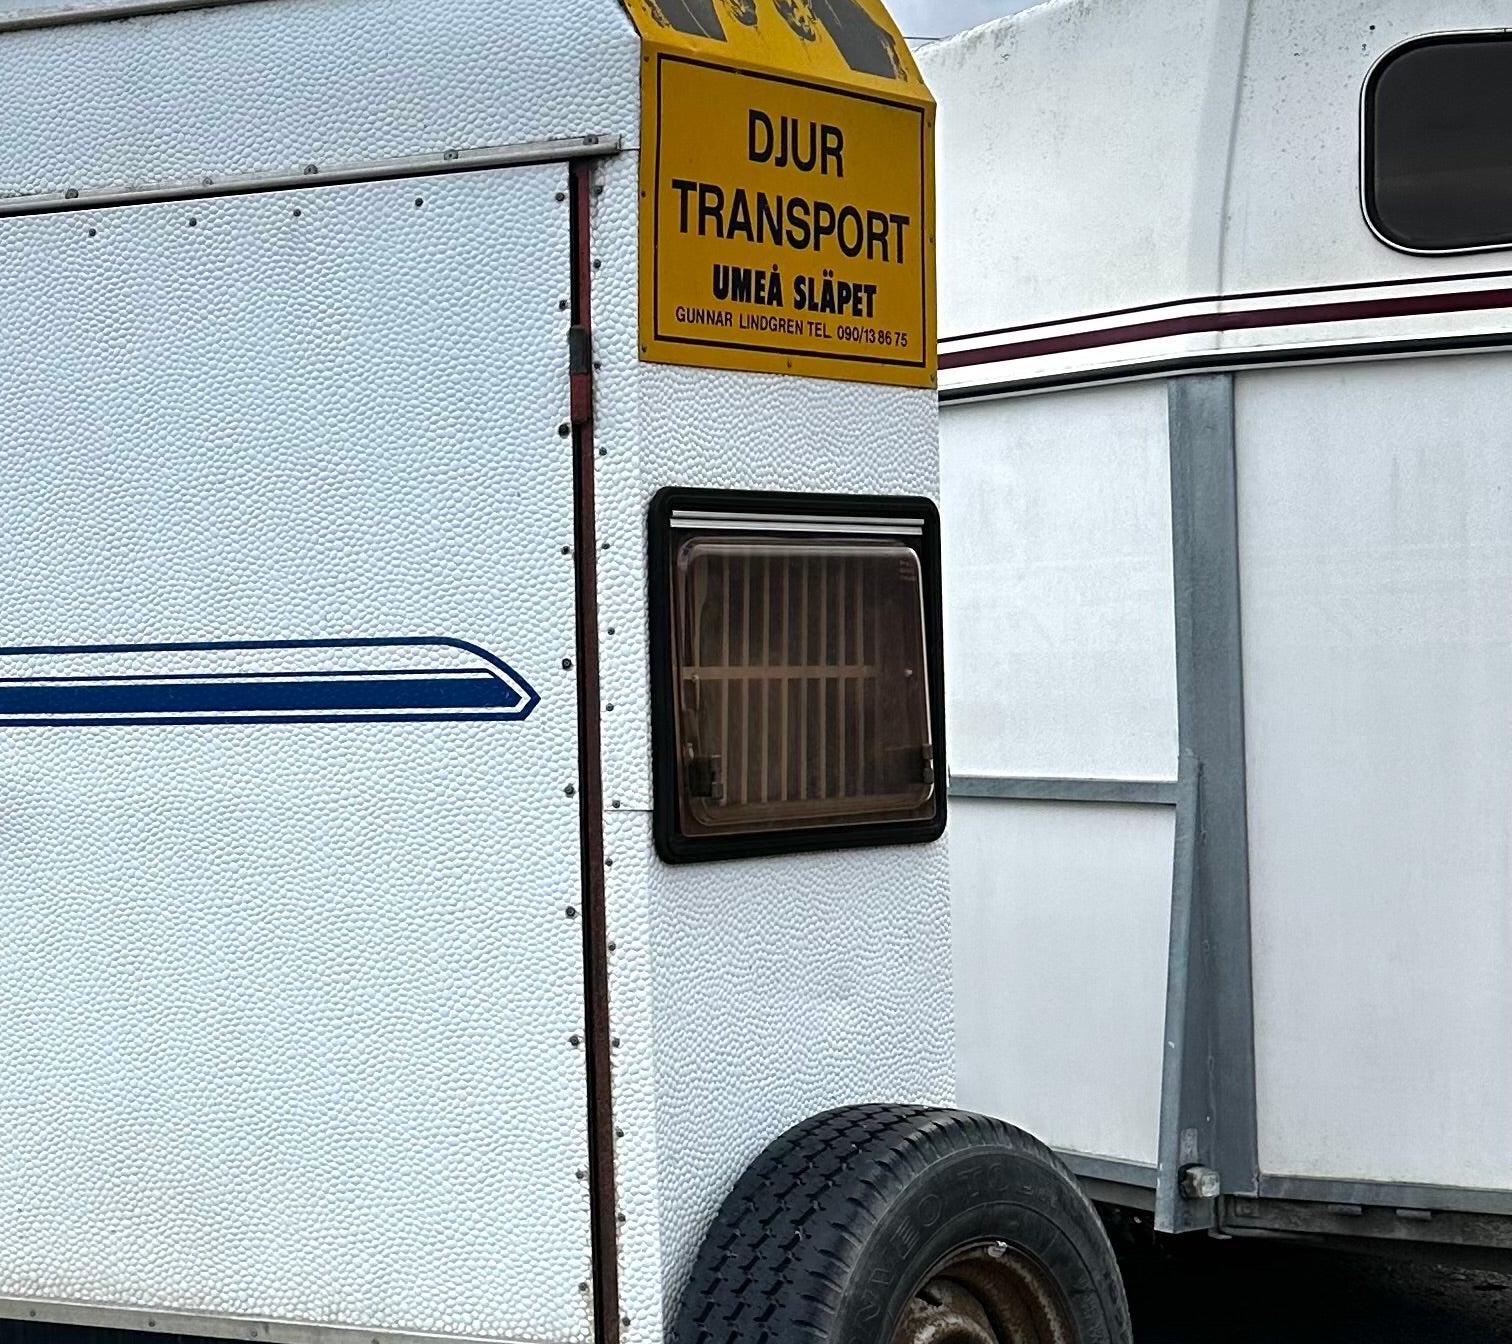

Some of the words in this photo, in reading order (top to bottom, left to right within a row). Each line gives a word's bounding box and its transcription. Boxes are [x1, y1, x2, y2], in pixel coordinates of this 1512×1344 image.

[748, 109, 844, 178] DJUR
[672, 178, 910, 264] TRANSPORT
[675, 306, 733, 327] GUNNAR
[739, 314, 804, 336] LINDGREN
[713, 263, 784, 307] UMEÅ
[793, 269, 877, 318] SLÄPET
